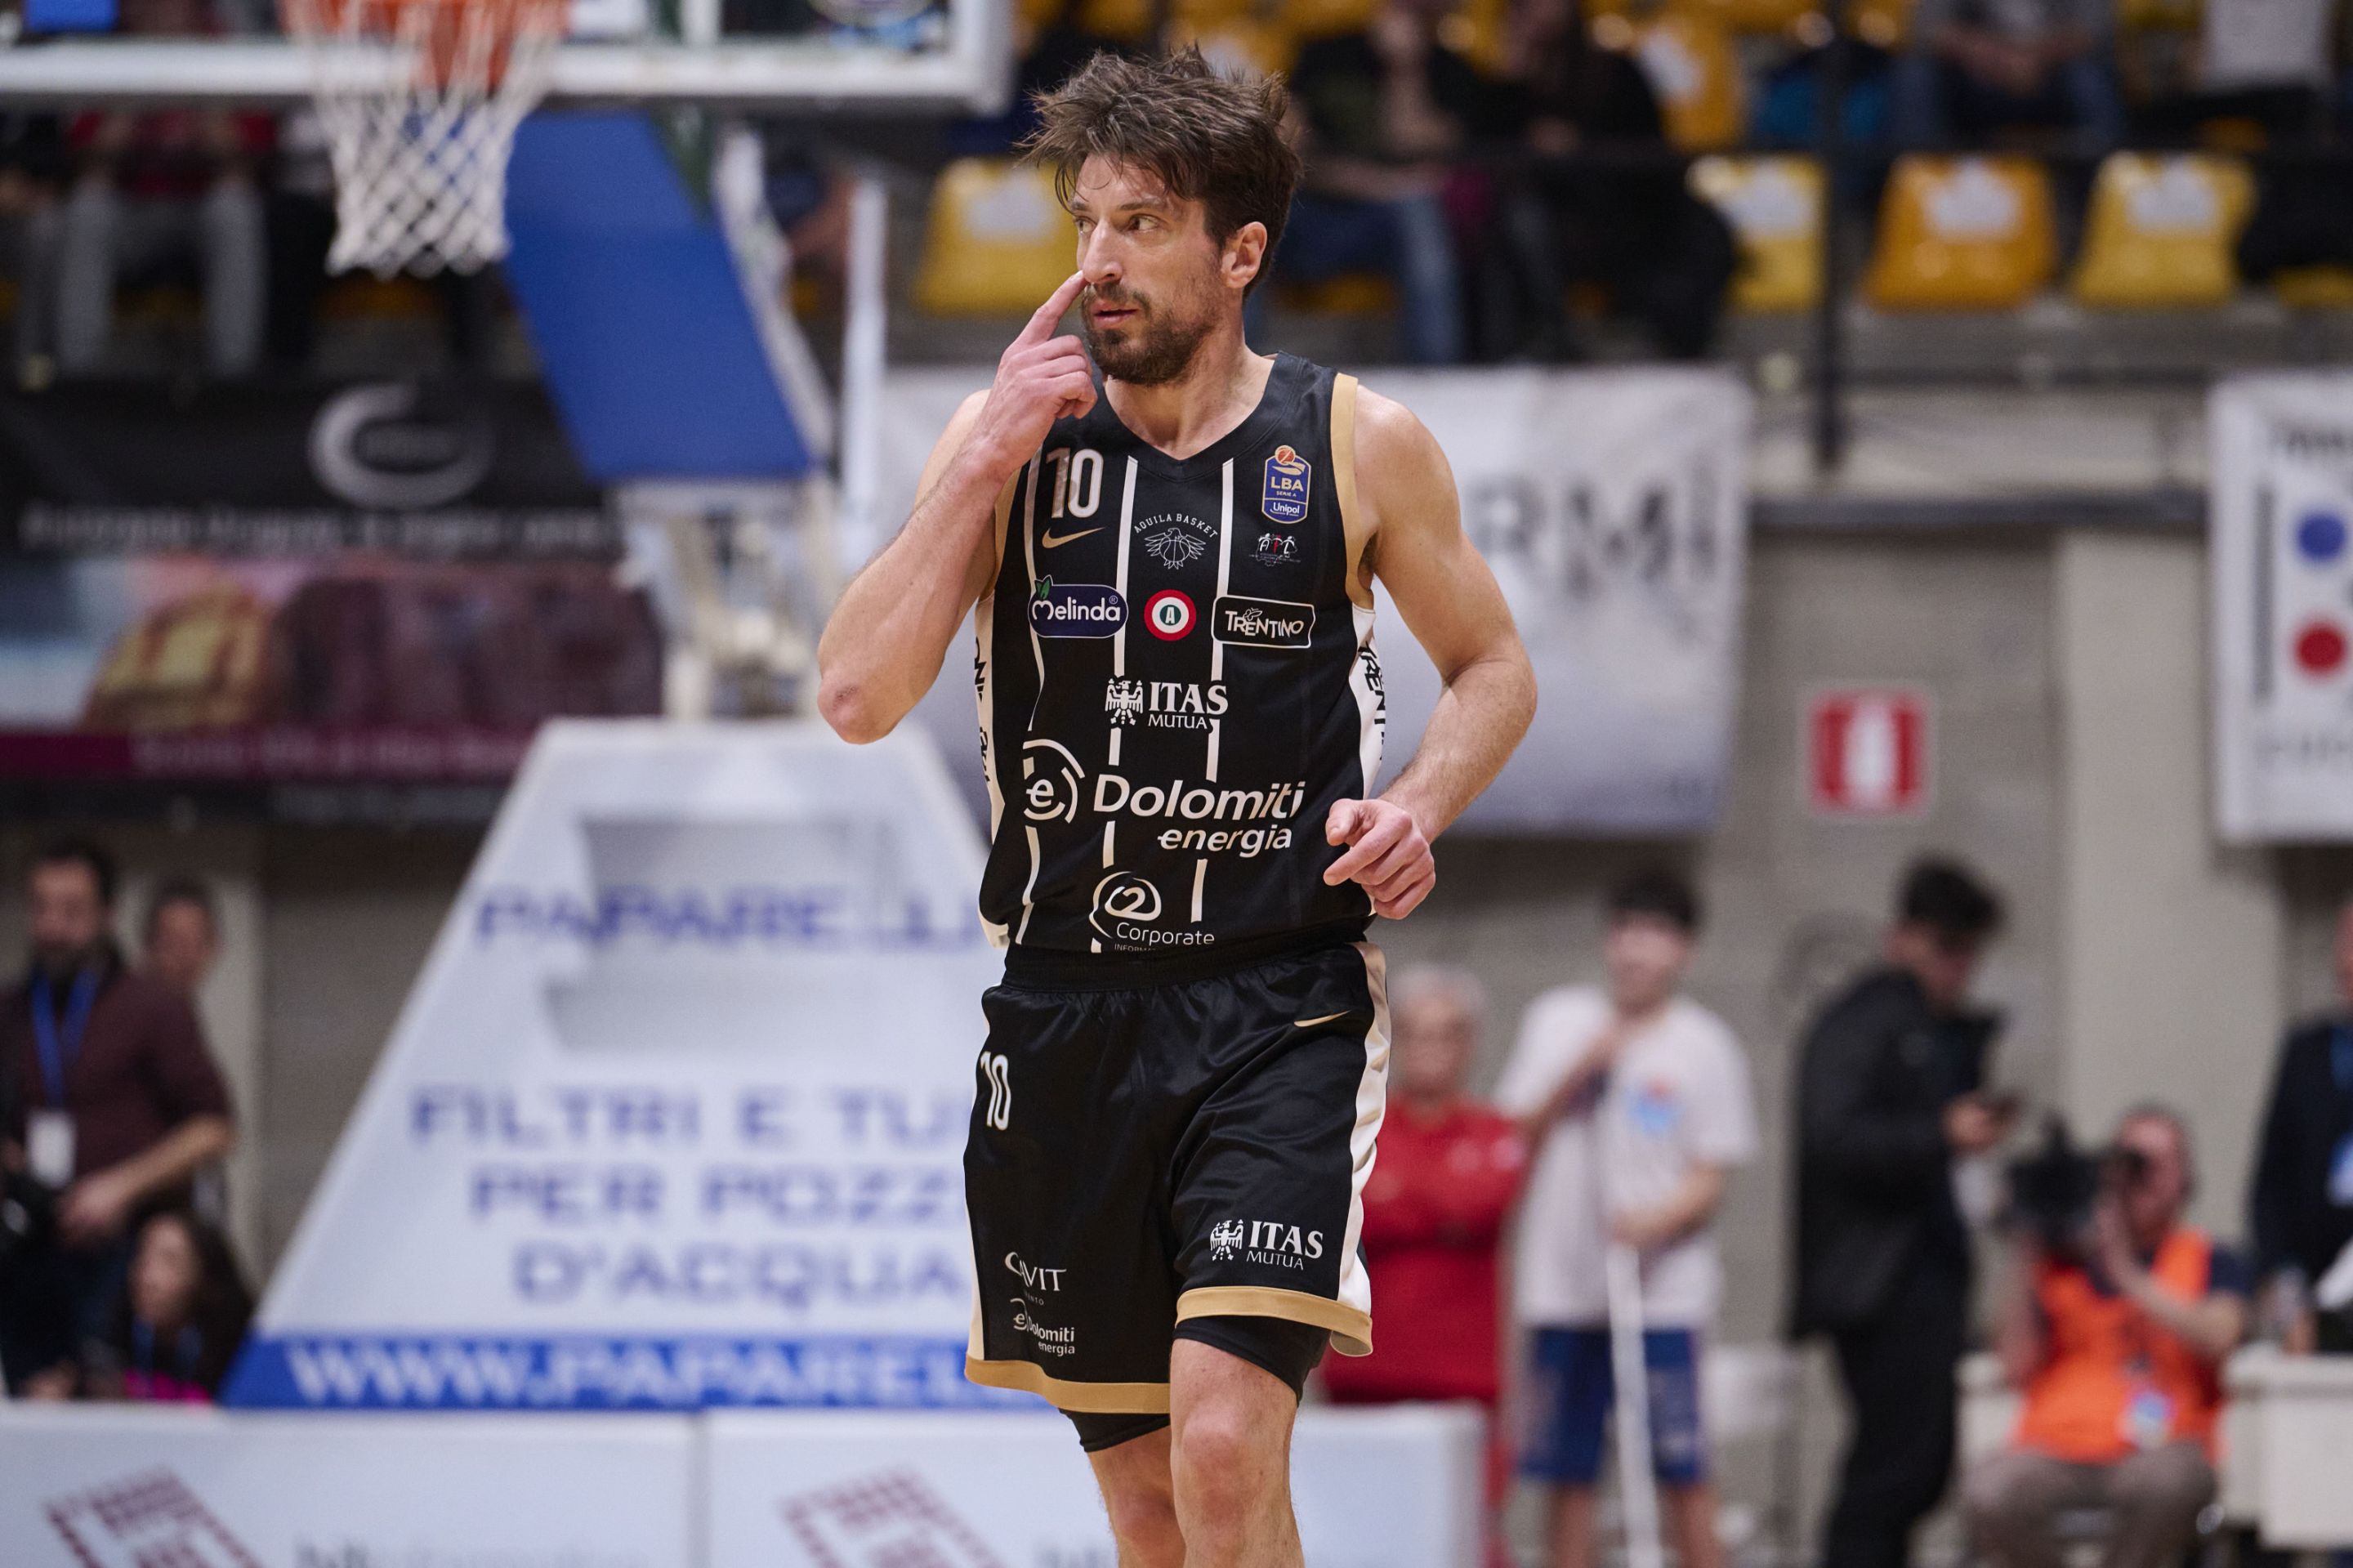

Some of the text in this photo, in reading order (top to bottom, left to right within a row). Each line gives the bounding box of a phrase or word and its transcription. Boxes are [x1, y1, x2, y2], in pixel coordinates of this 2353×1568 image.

[1046, 448, 1105, 519] 10
[1270, 476, 1304, 492] LBA
[1273, 502, 1300, 516] Unipol
[1134, 513, 1218, 538] AQUILA BASKET
[1032, 596, 1121, 621] Melinda
[1165, 606, 1176, 624] A
[1226, 610, 1305, 638] TRENTINO
[1149, 681, 1229, 716] ITAS
[1148, 713, 1208, 730] MUTUA
[1093, 774, 1306, 820] Dolomiti
[1157, 825, 1292, 858] energia
[1116, 922, 1215, 946] Corporate
[980, 1050, 1012, 1131] 10
[409, 1085, 974, 1146] FILTRI E TU
[467, 1162, 970, 1226] PER POZZ
[1248, 1220, 1324, 1259] ITAS
[1246, 1250, 1304, 1271] MUTUA
[513, 1240, 970, 1317] D'ACQUA
[1028, 1316, 1075, 1342] Dolomiti
[1038, 1341, 1075, 1356] energia
[286, 1338, 970, 1404] WWW.PAPAREL
